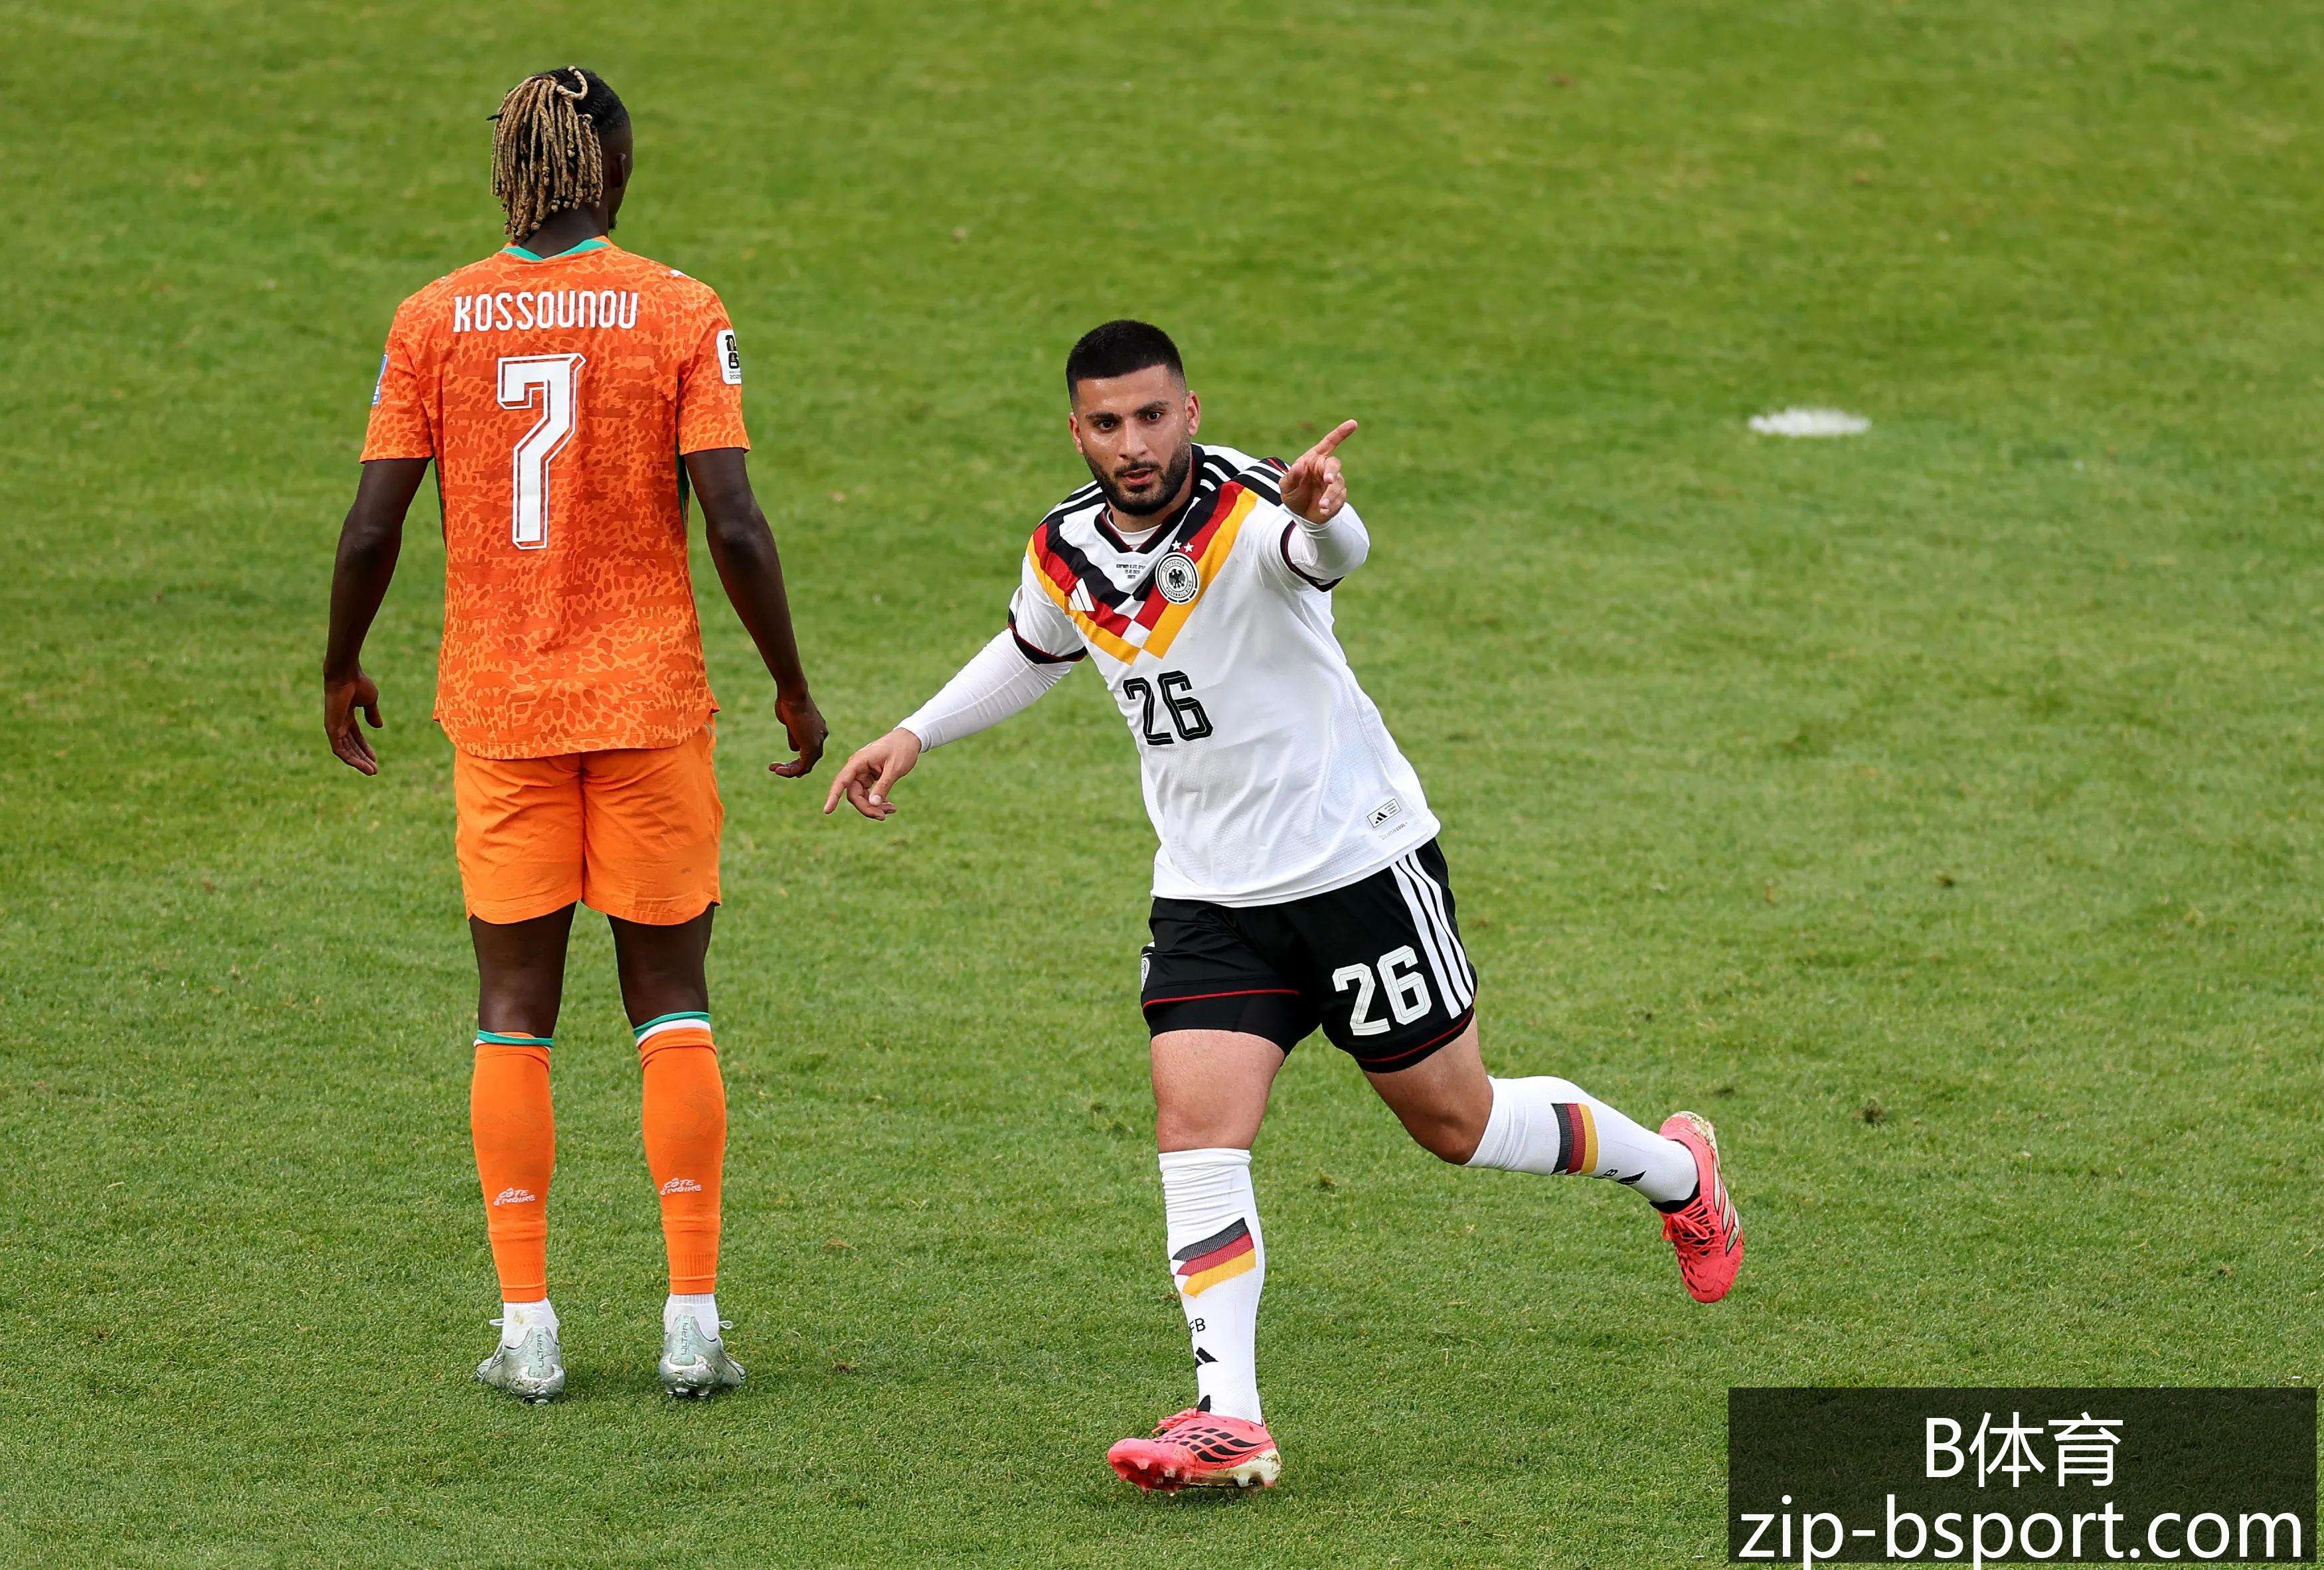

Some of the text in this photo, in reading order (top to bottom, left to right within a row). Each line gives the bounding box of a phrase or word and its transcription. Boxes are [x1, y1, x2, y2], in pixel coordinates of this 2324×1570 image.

[453, 290, 639, 332] KOSSOUNOU
[497, 353, 586, 550] 7
[1123, 670, 1214, 746] 26
[1332, 945, 1432, 1036] 26
